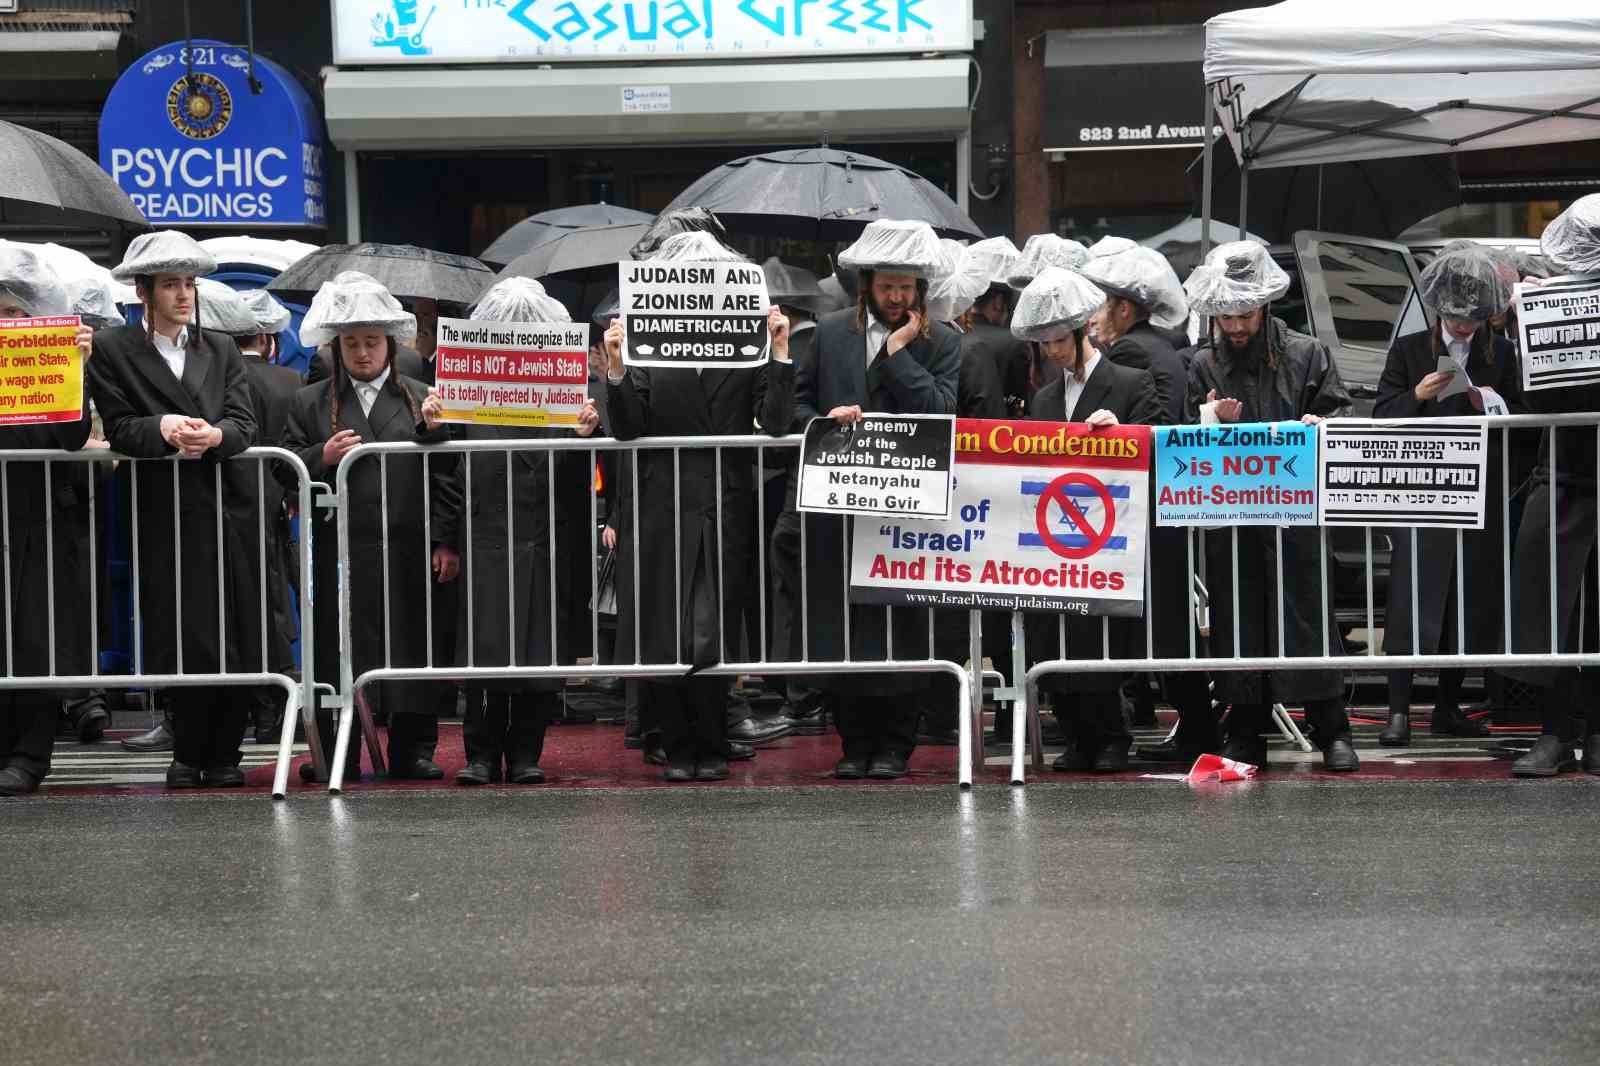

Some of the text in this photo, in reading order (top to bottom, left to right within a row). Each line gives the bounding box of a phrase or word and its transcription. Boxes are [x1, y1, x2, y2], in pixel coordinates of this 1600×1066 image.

[179, 47, 217, 65] 821
[1079, 127, 1113, 141] 823
[1118, 125, 1153, 140] 2nd
[111, 147, 288, 188] PSYCHIC
[129, 192, 273, 218] READINGS
[628, 267, 762, 285] JUDAISM AND
[632, 293, 760, 311] ZIONISM ARE
[633, 318, 761, 333] DIAMETRICALLY
[0, 334, 78, 348] Forbidden
[442, 325, 583, 349] The world must recognize that
[660, 342, 735, 357] OPPOSED
[11, 356, 36, 367] own
[38, 352, 71, 367] State,
[441, 353, 583, 377] Israel is NOT a Jewish State
[5, 374, 36, 389] wage
[39, 373, 65, 385] wars
[20, 391, 55, 405] nation
[448, 384, 456, 399] is
[458, 385, 488, 406] totally
[491, 387, 529, 406] rejected
[532, 388, 543, 408] by
[545, 389, 584, 405] Judaism
[863, 421, 918, 436] enemy
[1165, 427, 1306, 448] Anti-Zionism
[857, 436, 897, 450] of the
[988, 425, 1139, 459] Condemns
[1327, 439, 1480, 450] חברי הכנסת המתפשרים
[816, 451, 937, 470] Jewish People
[1191, 455, 1282, 476] is NOT
[829, 471, 921, 490] Netanyahu
[827, 492, 921, 510] & Ben Gvir
[1158, 484, 1314, 506] Anti-Semitism
[1354, 493, 1378, 503] הדם
[1384, 493, 1400, 504] את
[960, 499, 991, 523] of
[1160, 511, 1313, 521] Judaism and Zionism are Diametrically Opposed
[879, 525, 985, 552] “Israel”
[869, 554, 1125, 591] And its Atrocities
[906, 591, 1089, 615] www.IsraelVersusJudaism.org
